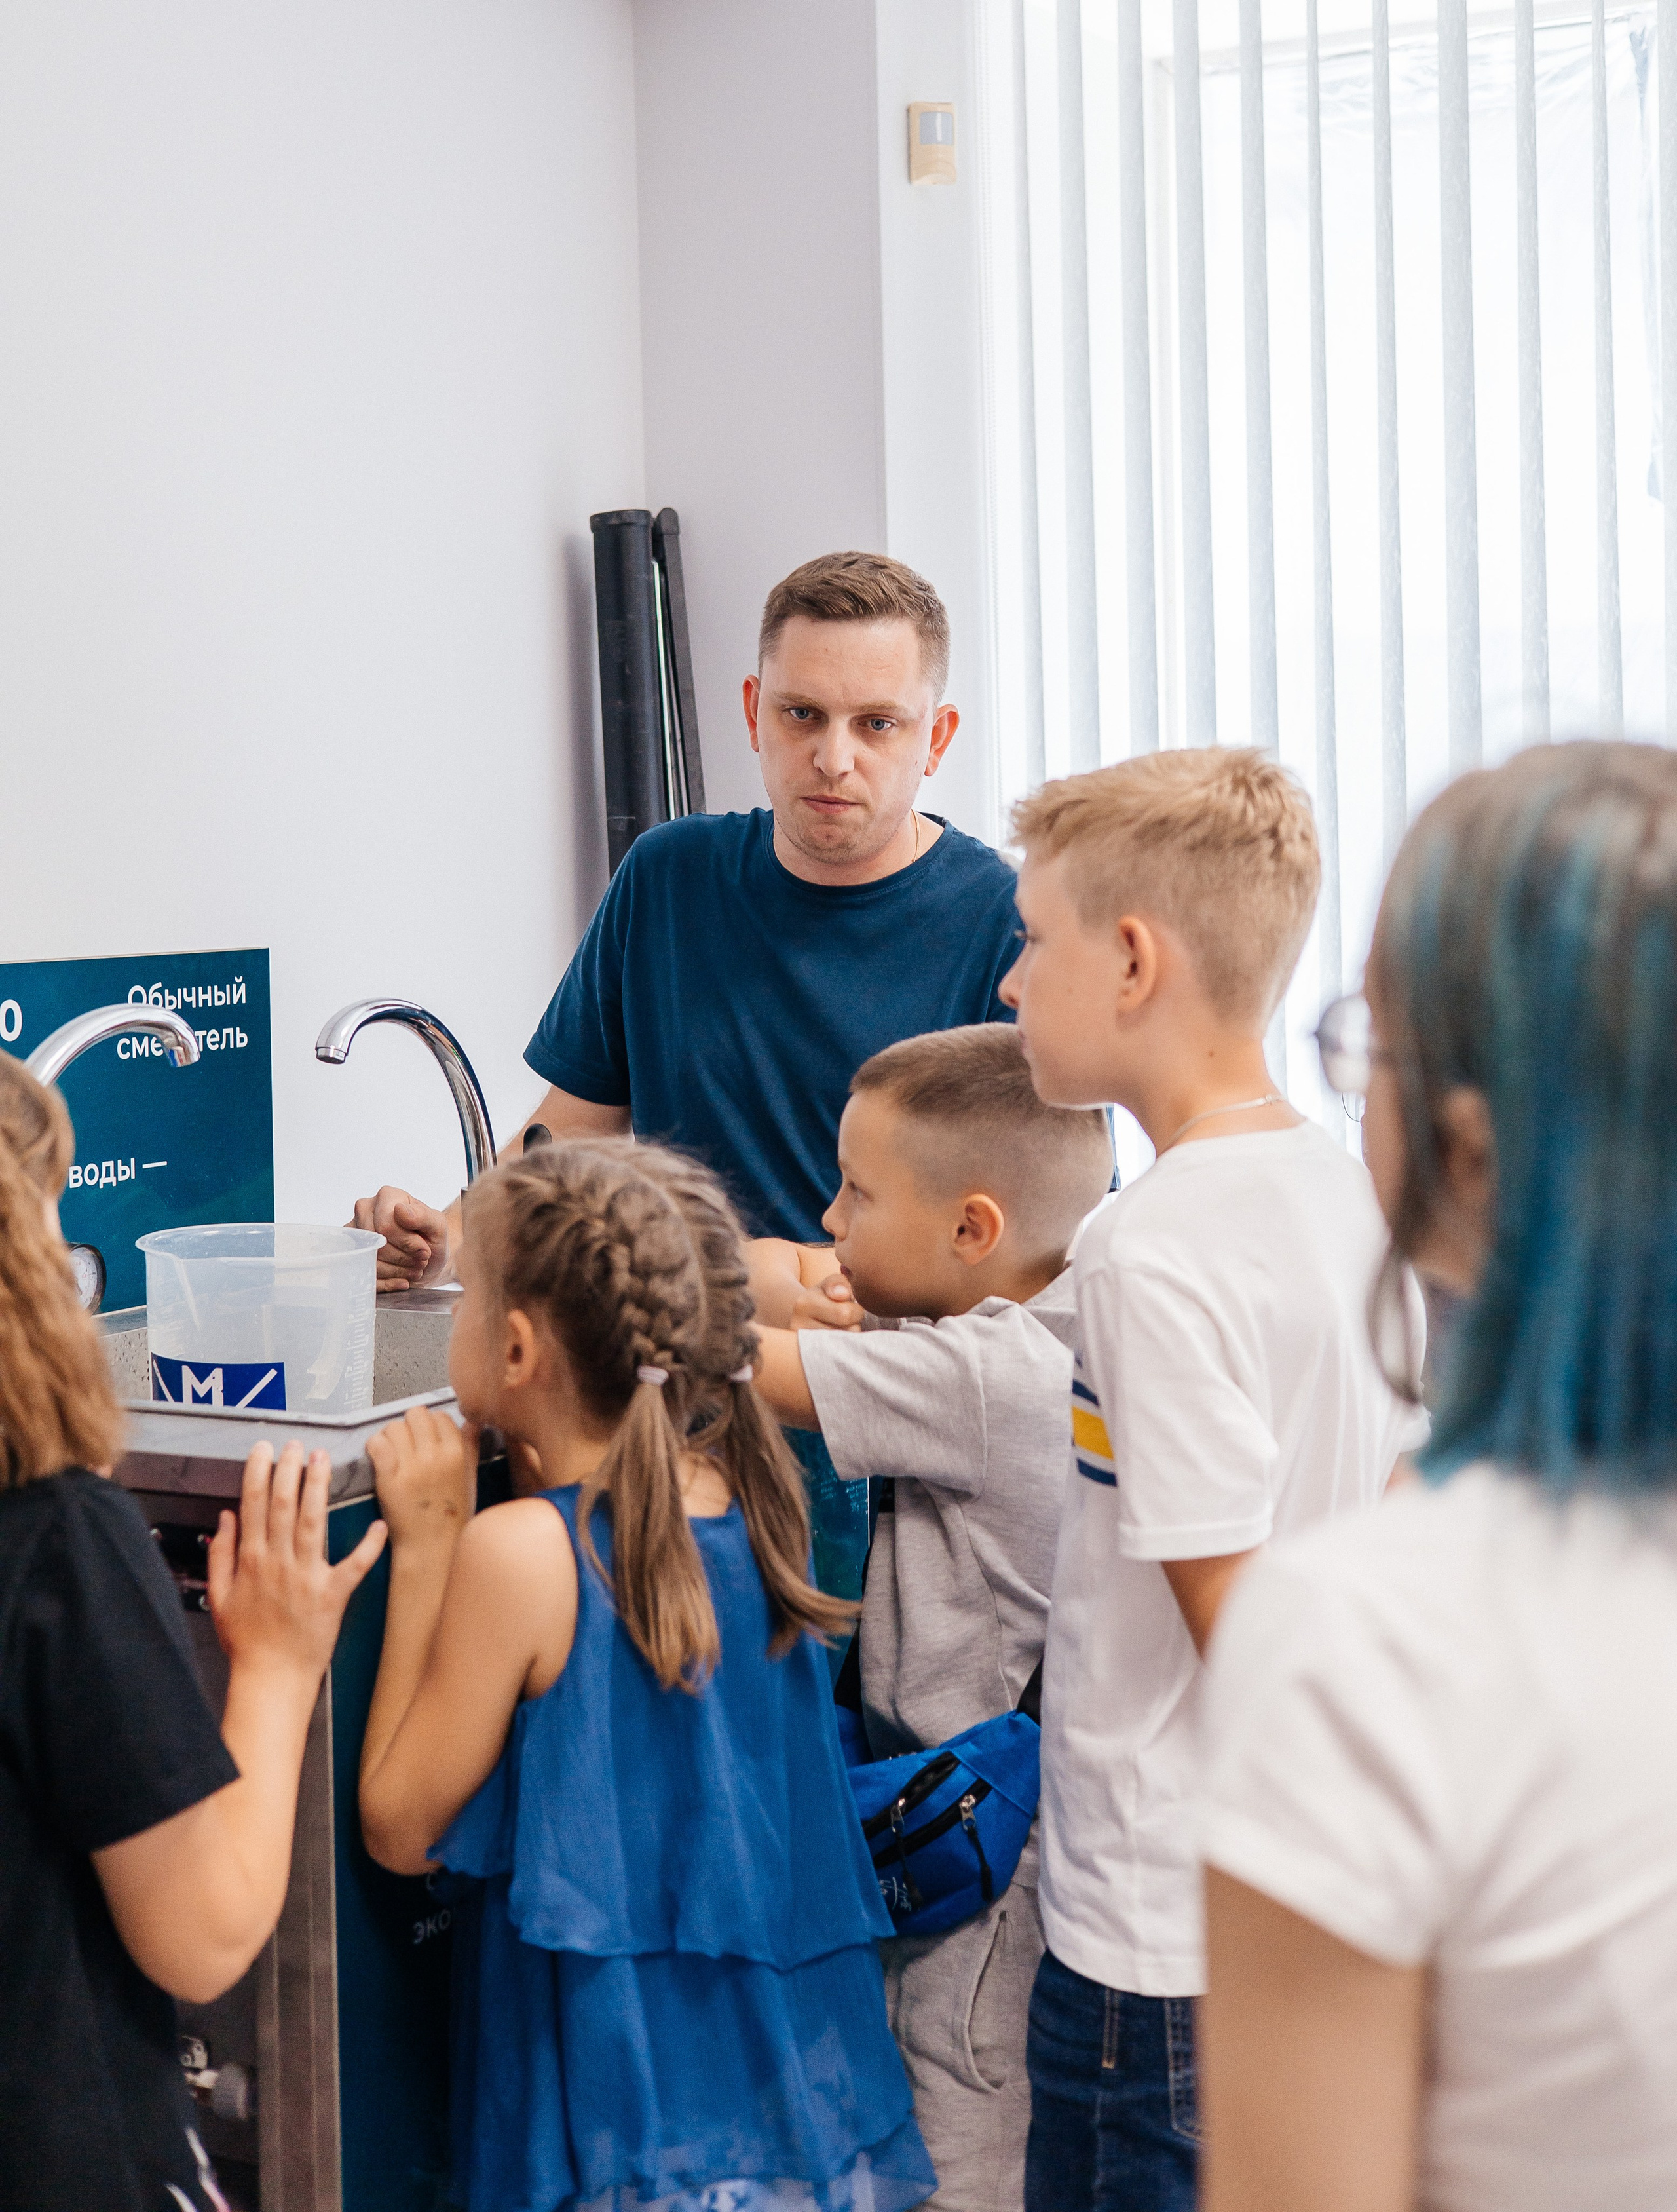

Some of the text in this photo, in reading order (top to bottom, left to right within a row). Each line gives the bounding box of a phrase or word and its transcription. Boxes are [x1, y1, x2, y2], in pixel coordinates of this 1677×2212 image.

[127, 976, 246, 1010] Обычный
[117, 1027, 248, 1059] сметель
[69, 1157, 135, 1189] воды
